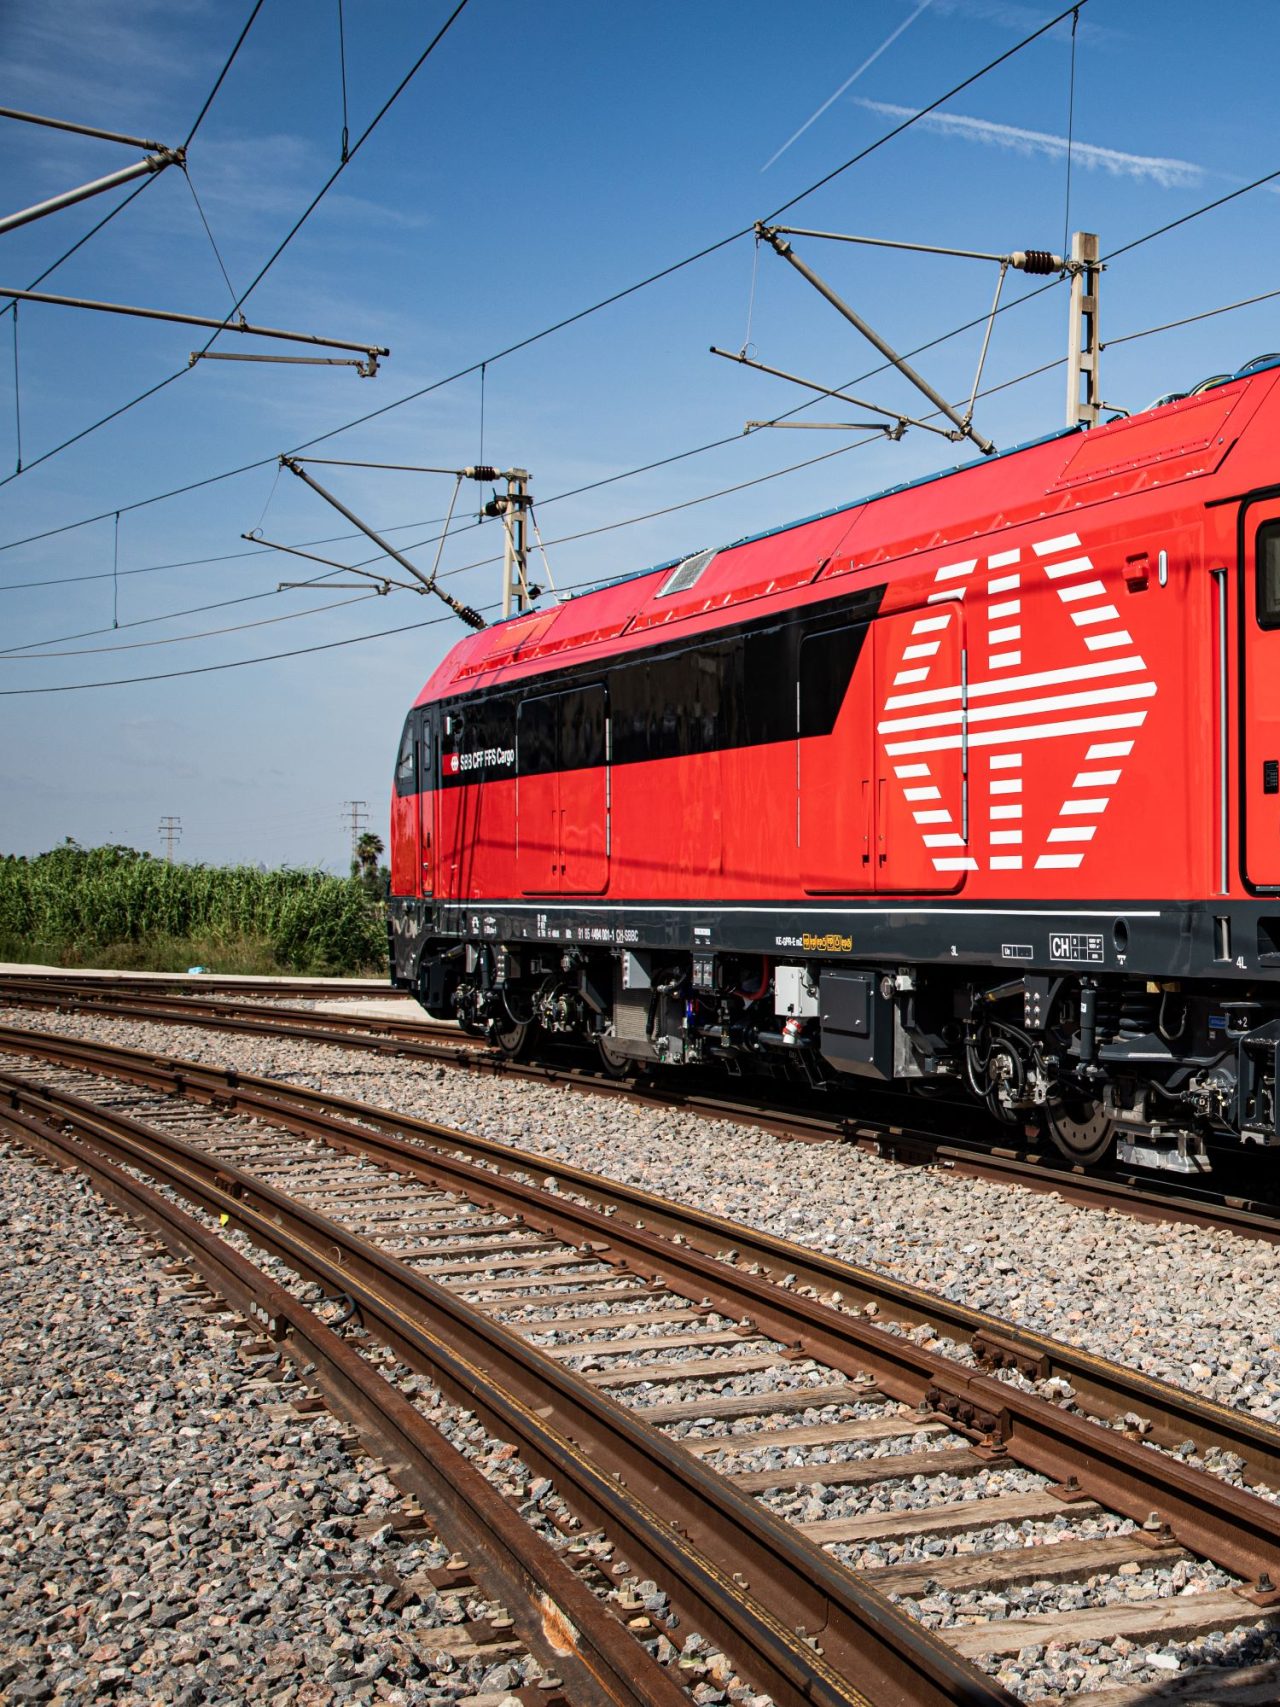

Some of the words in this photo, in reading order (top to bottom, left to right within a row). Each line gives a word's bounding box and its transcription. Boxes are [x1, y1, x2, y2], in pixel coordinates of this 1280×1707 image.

[460, 753, 472, 771] SBB
[472, 751, 484, 769] CFF
[484, 748, 496, 767] FFS
[497, 747, 515, 766] Cargo
[1052, 937, 1070, 957] CH
[1236, 955, 1247, 969] 4L
